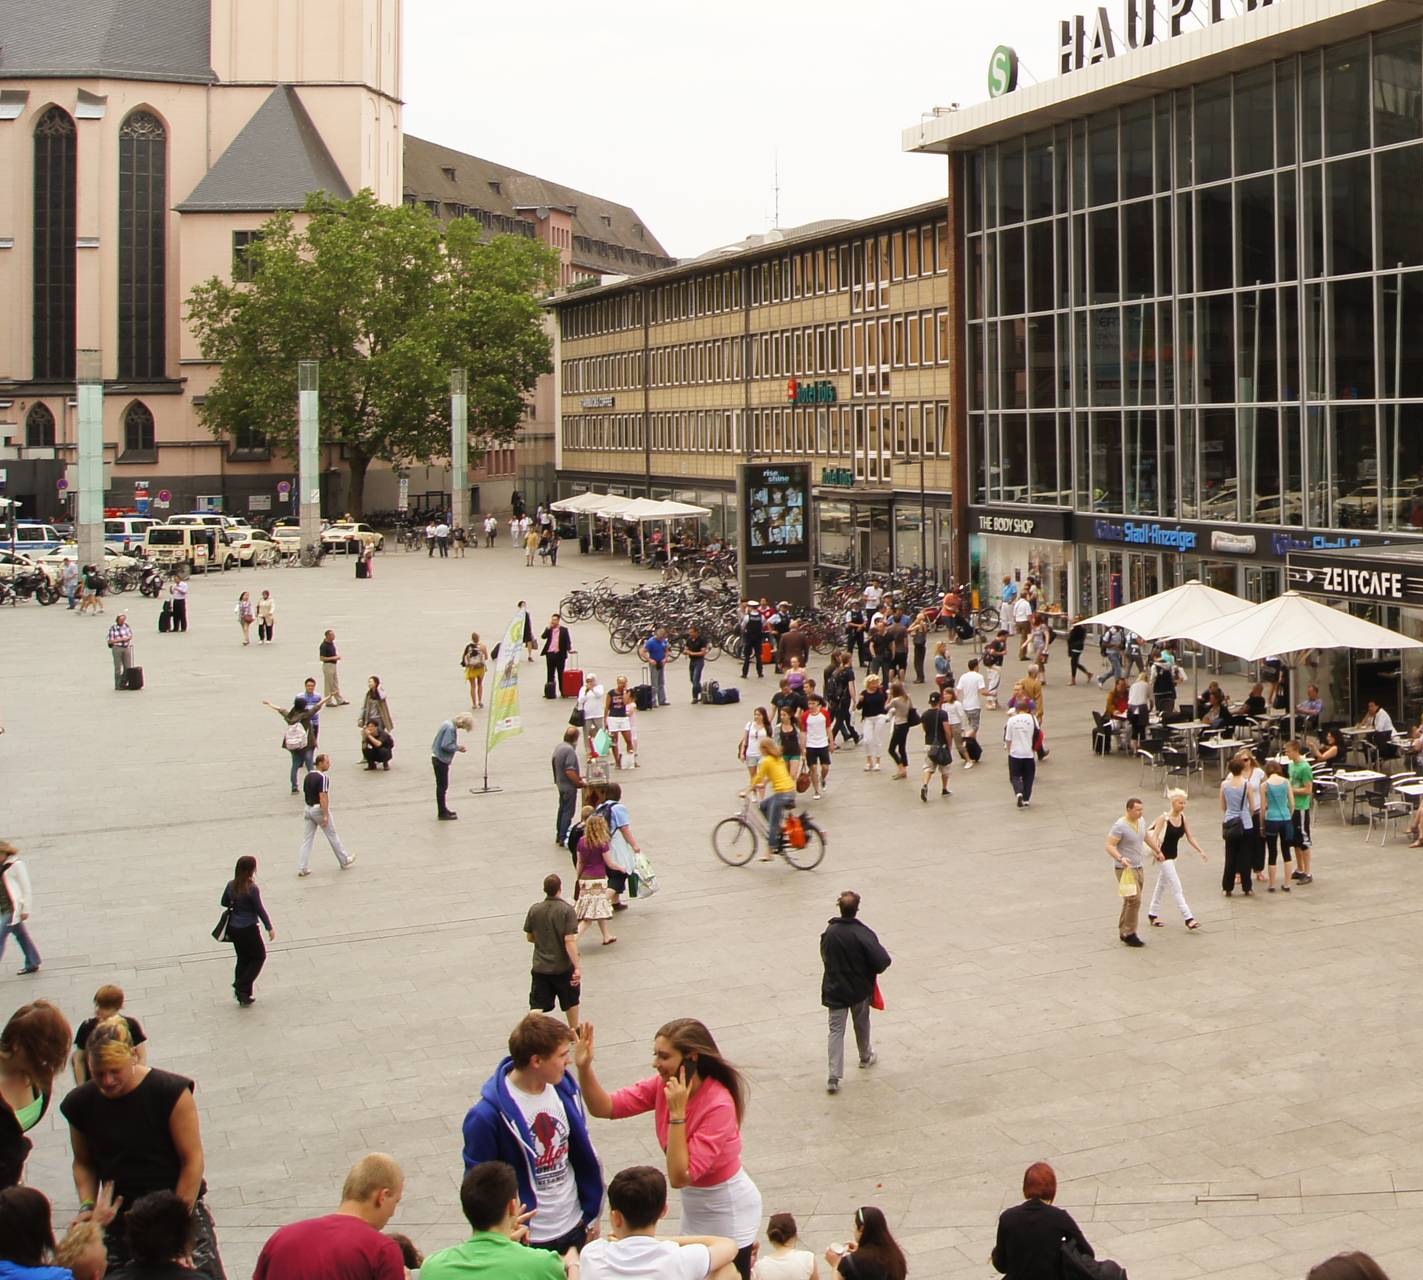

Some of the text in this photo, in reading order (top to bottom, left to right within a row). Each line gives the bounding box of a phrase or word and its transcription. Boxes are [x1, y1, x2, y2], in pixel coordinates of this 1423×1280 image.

[979, 516, 1034, 534] THE BODY SHOP
